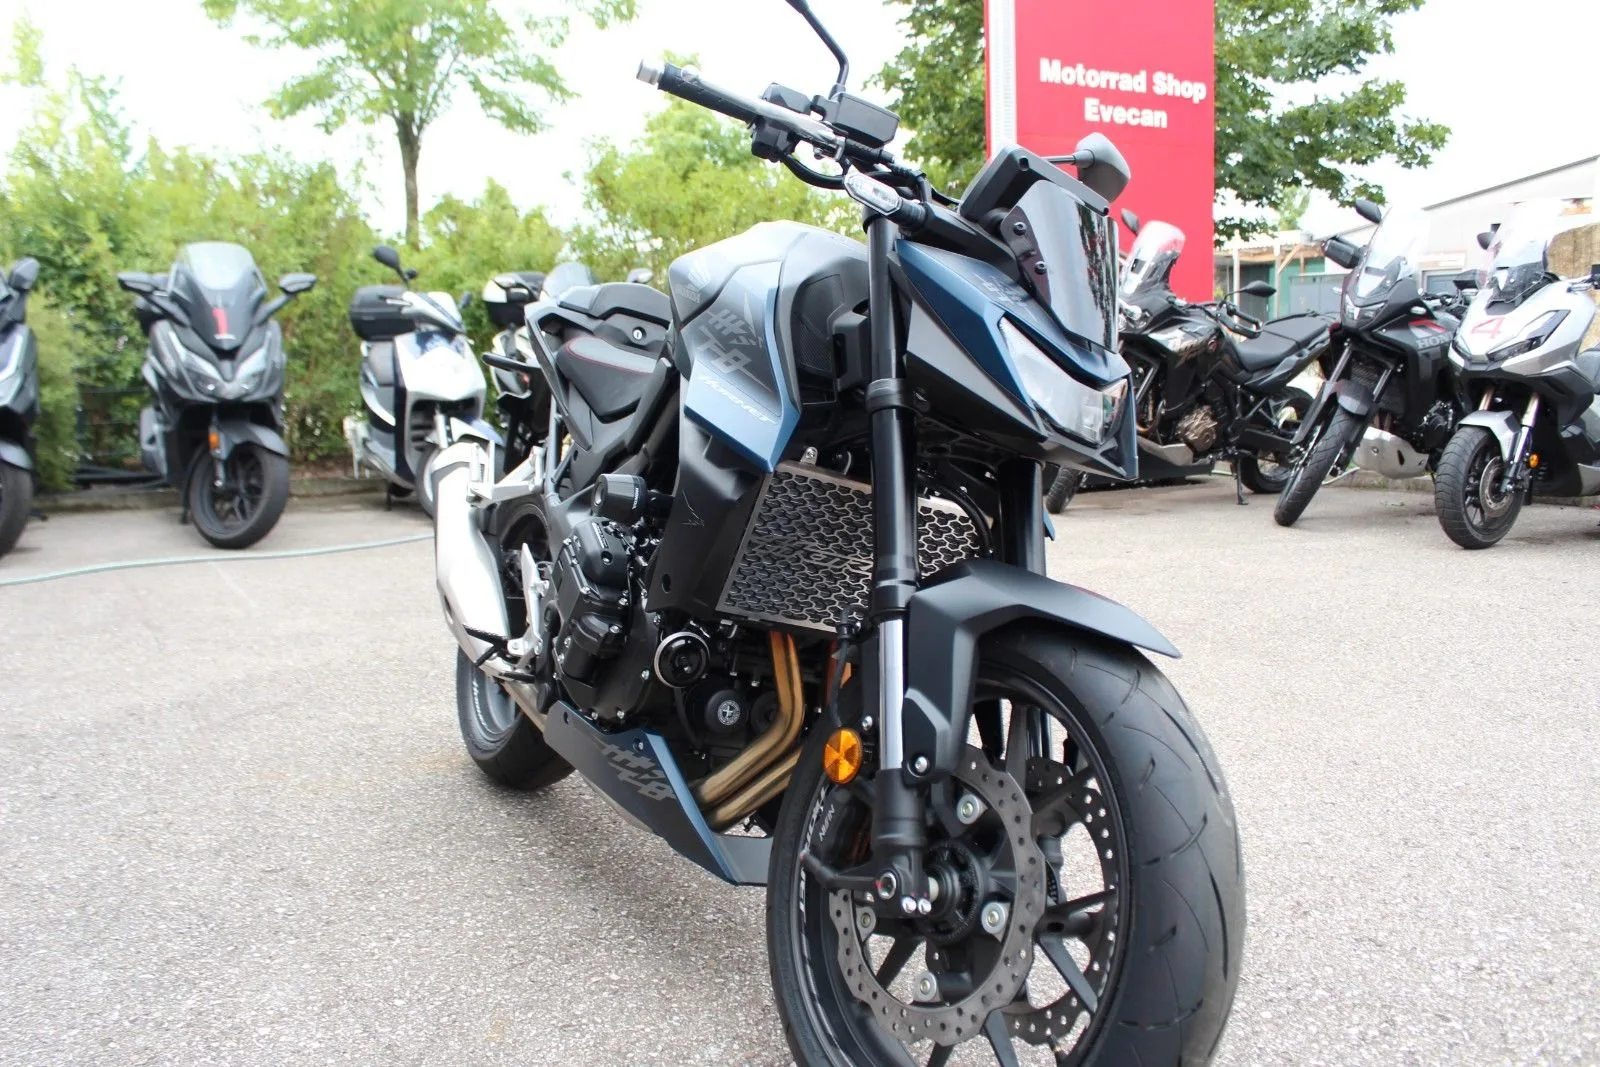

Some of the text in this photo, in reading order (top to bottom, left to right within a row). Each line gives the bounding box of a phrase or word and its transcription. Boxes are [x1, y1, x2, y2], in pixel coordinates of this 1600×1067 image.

[1039, 57, 1207, 104] Motorrad Shop
[1084, 97, 1168, 129] Evecan
[1416, 331, 1453, 349] HON
[1471, 316, 1505, 339] 4
